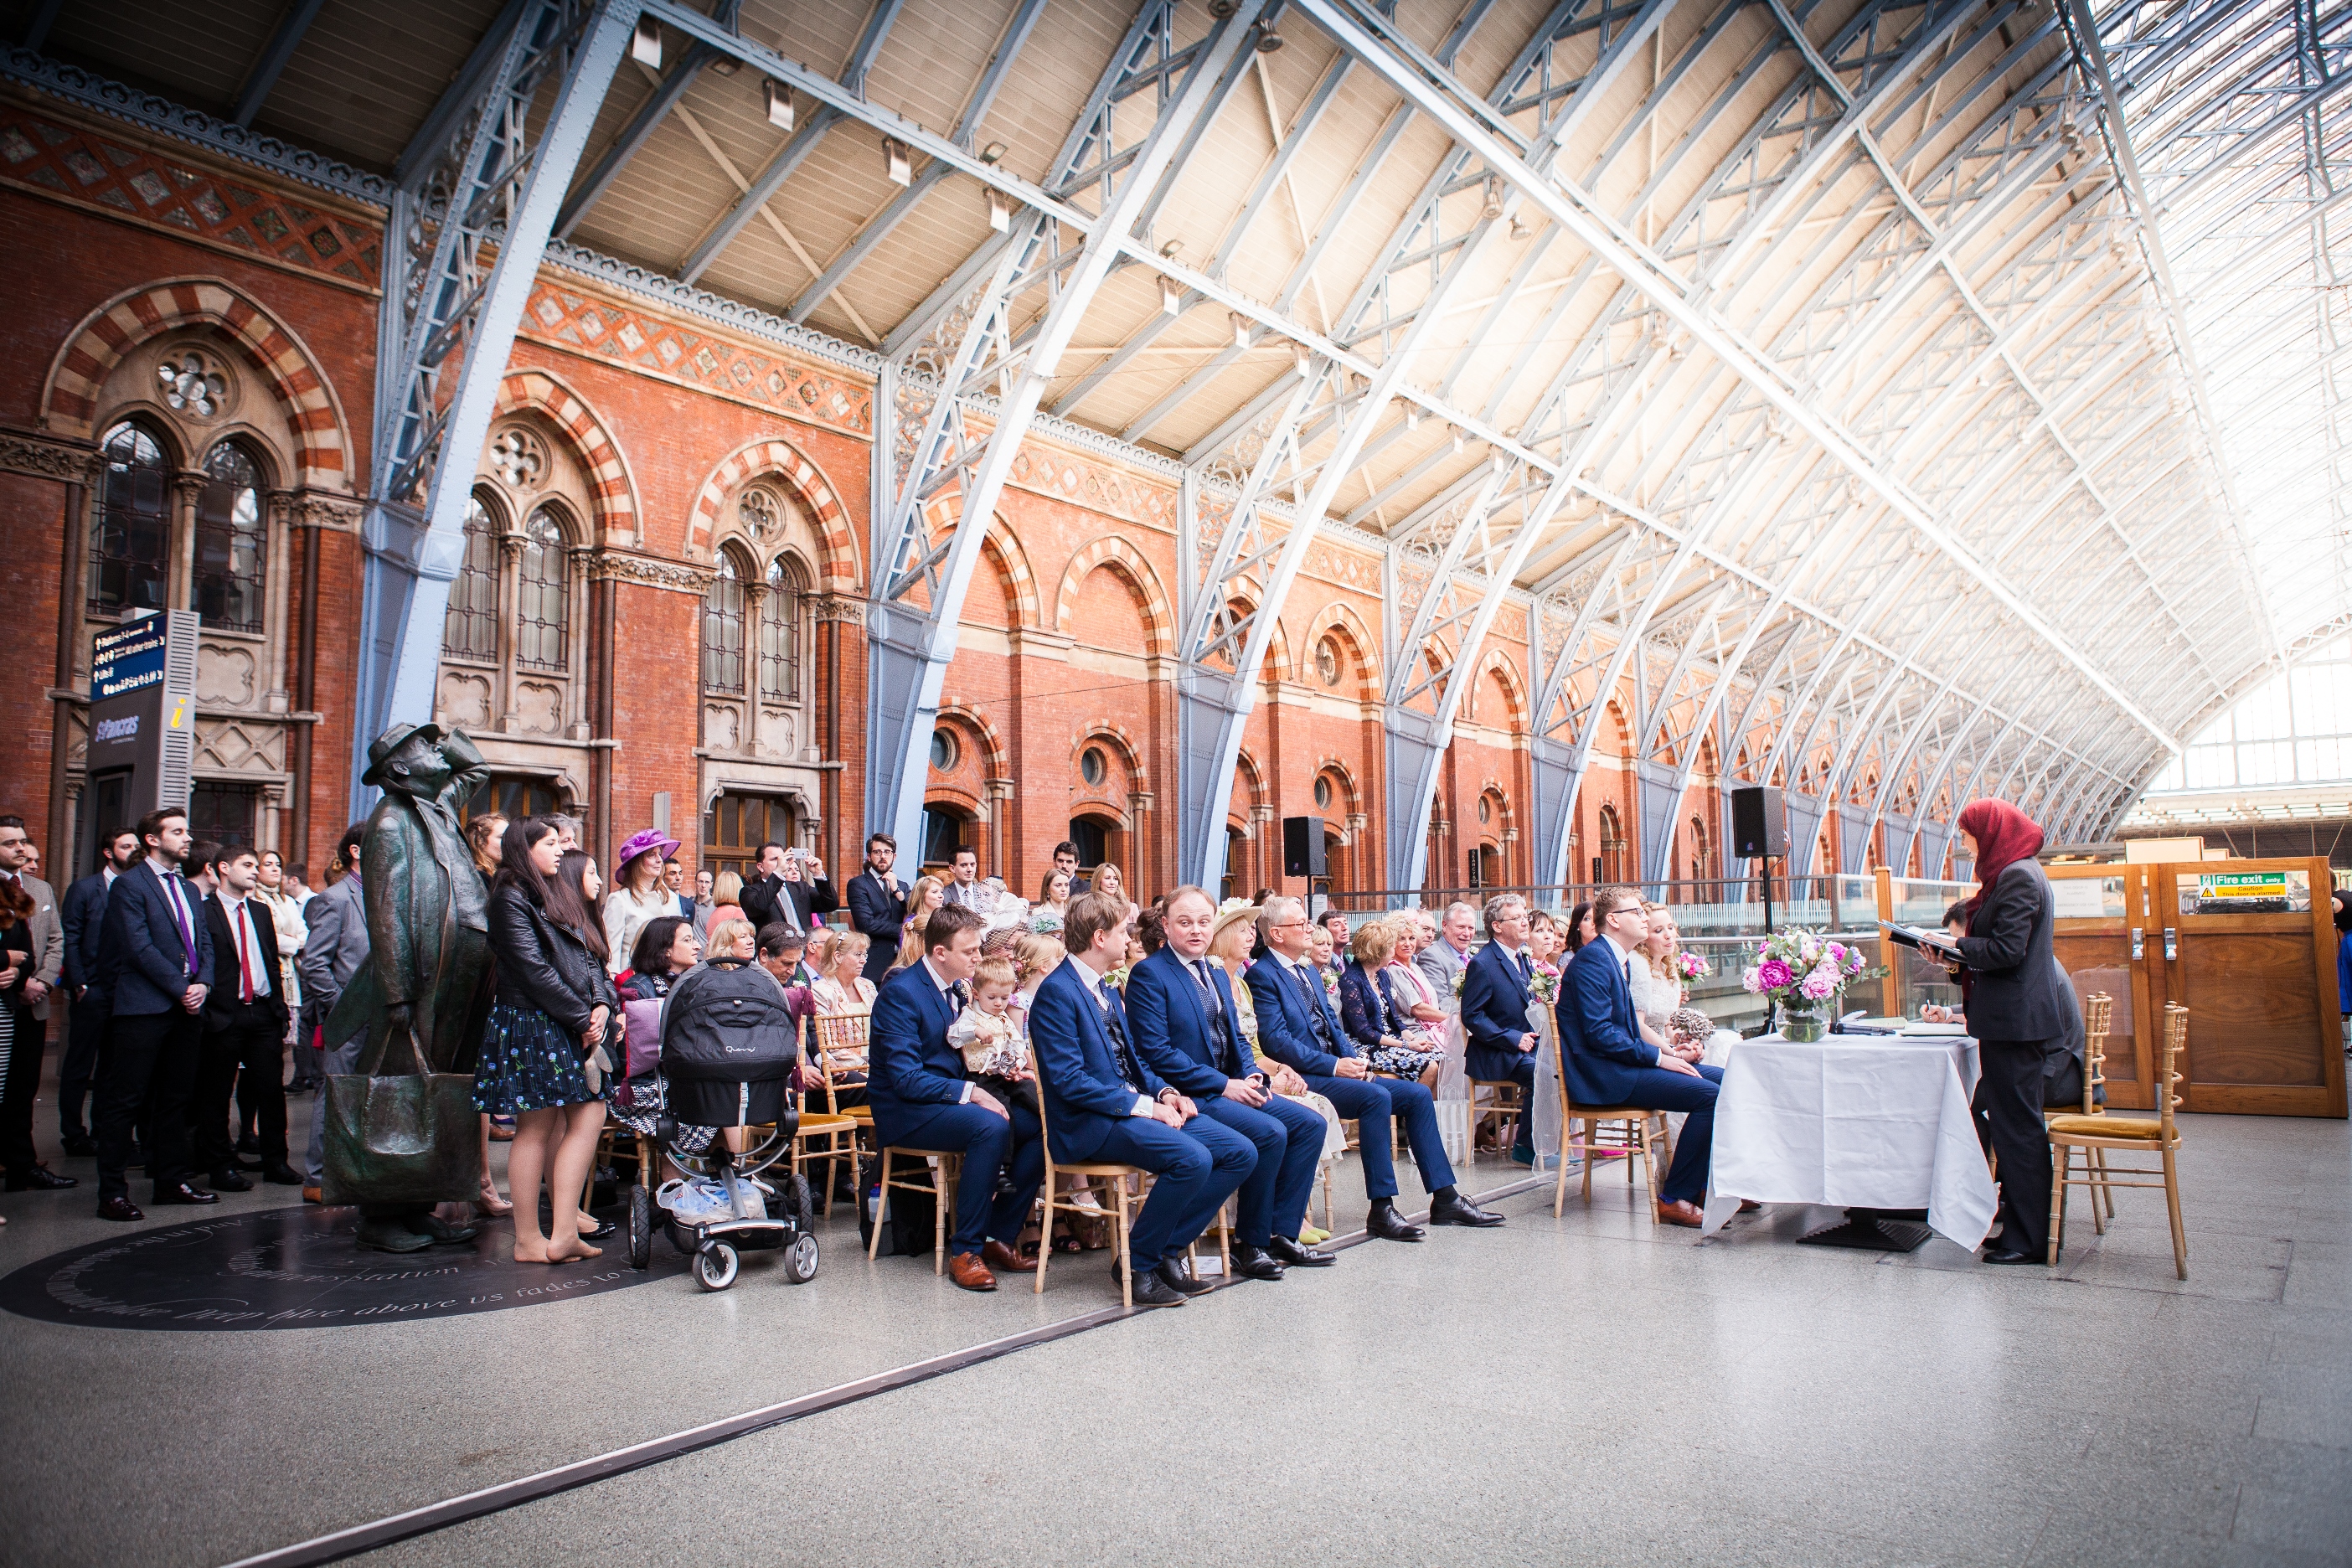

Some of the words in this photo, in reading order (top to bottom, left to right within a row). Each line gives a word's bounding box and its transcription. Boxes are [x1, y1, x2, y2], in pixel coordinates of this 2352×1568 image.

[2216, 875, 2238, 885] Fire
[2241, 874, 2262, 885] exit
[725, 1045, 756, 1054] Quinny
[266, 1308, 346, 1320] blue
[353, 1298, 459, 1317] above
[469, 1292, 504, 1305] us
[515, 1277, 591, 1298] fades
[592, 1271, 621, 1283] to
